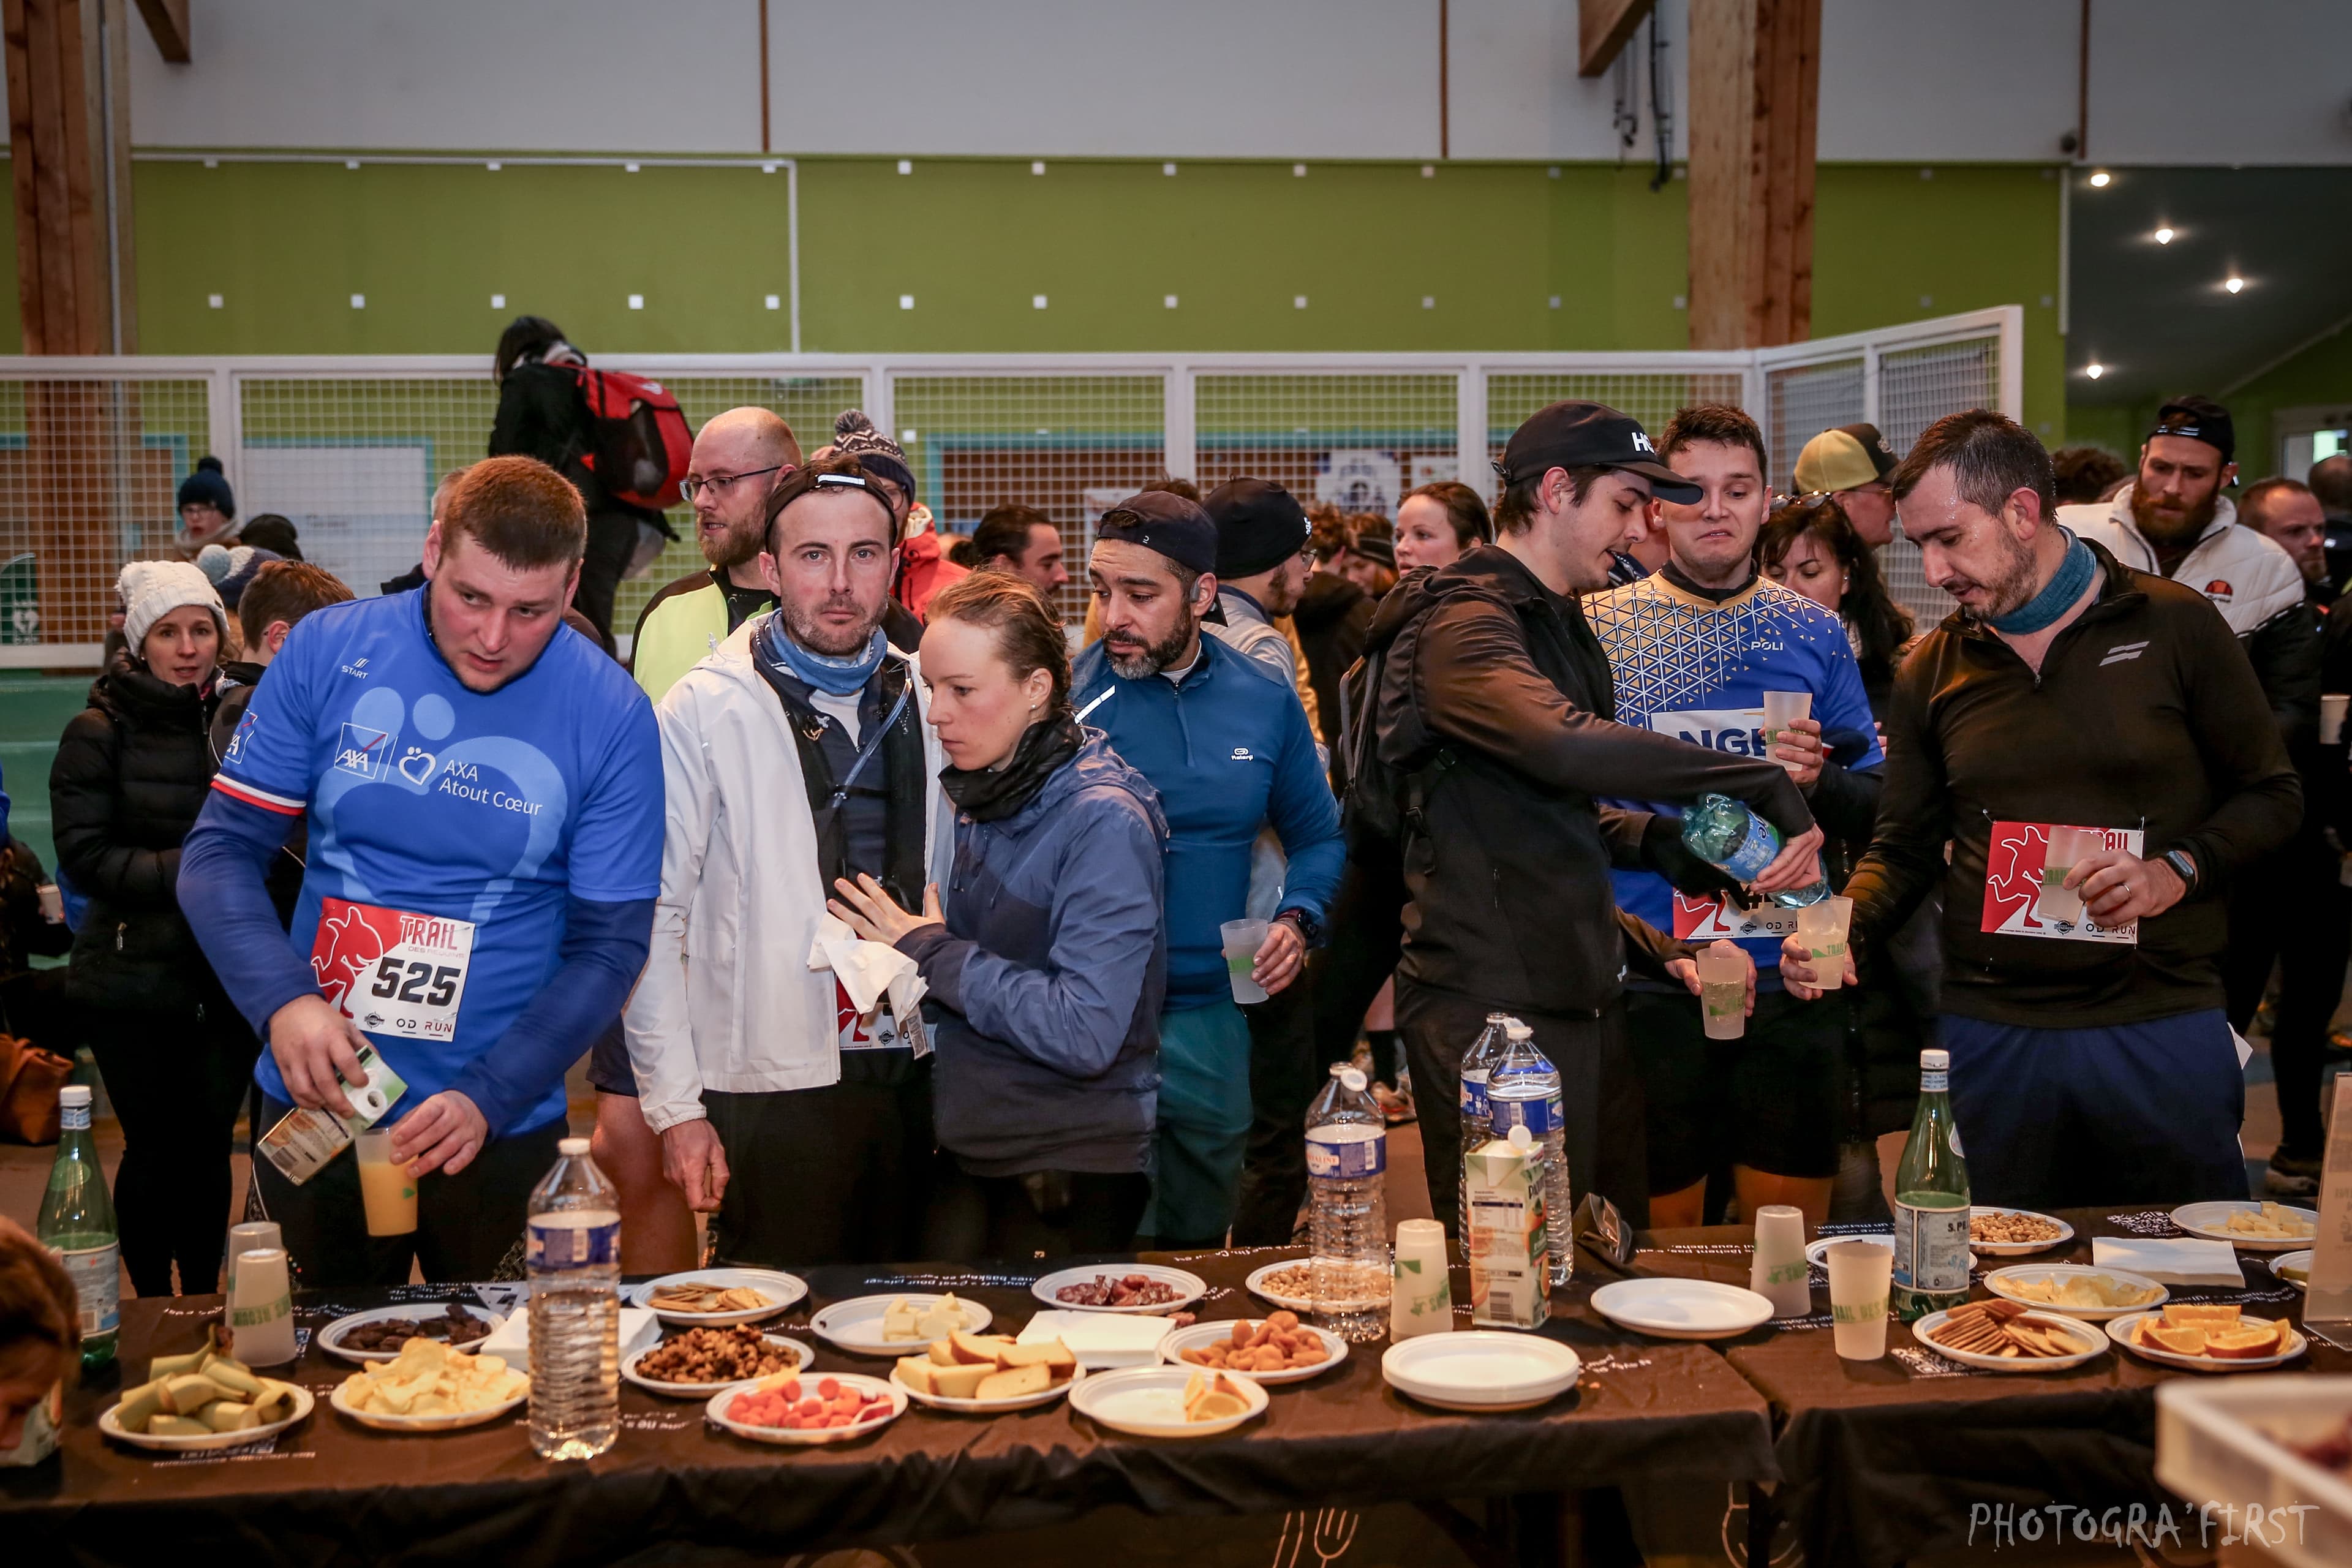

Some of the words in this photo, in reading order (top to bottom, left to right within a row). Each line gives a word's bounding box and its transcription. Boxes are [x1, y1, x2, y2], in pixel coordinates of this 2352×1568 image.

[342, 665, 369, 679] START
[336, 748, 369, 772] AXA
[443, 759, 478, 782] AXA
[439, 777, 488, 804] Atout
[492, 791, 543, 816] Cœur
[399, 916, 458, 950] TRAIL
[1766, 921, 1782, 930] OD
[371, 956, 461, 1007] 525
[396, 1018, 417, 1029] OD
[424, 1020, 452, 1033] RUN
